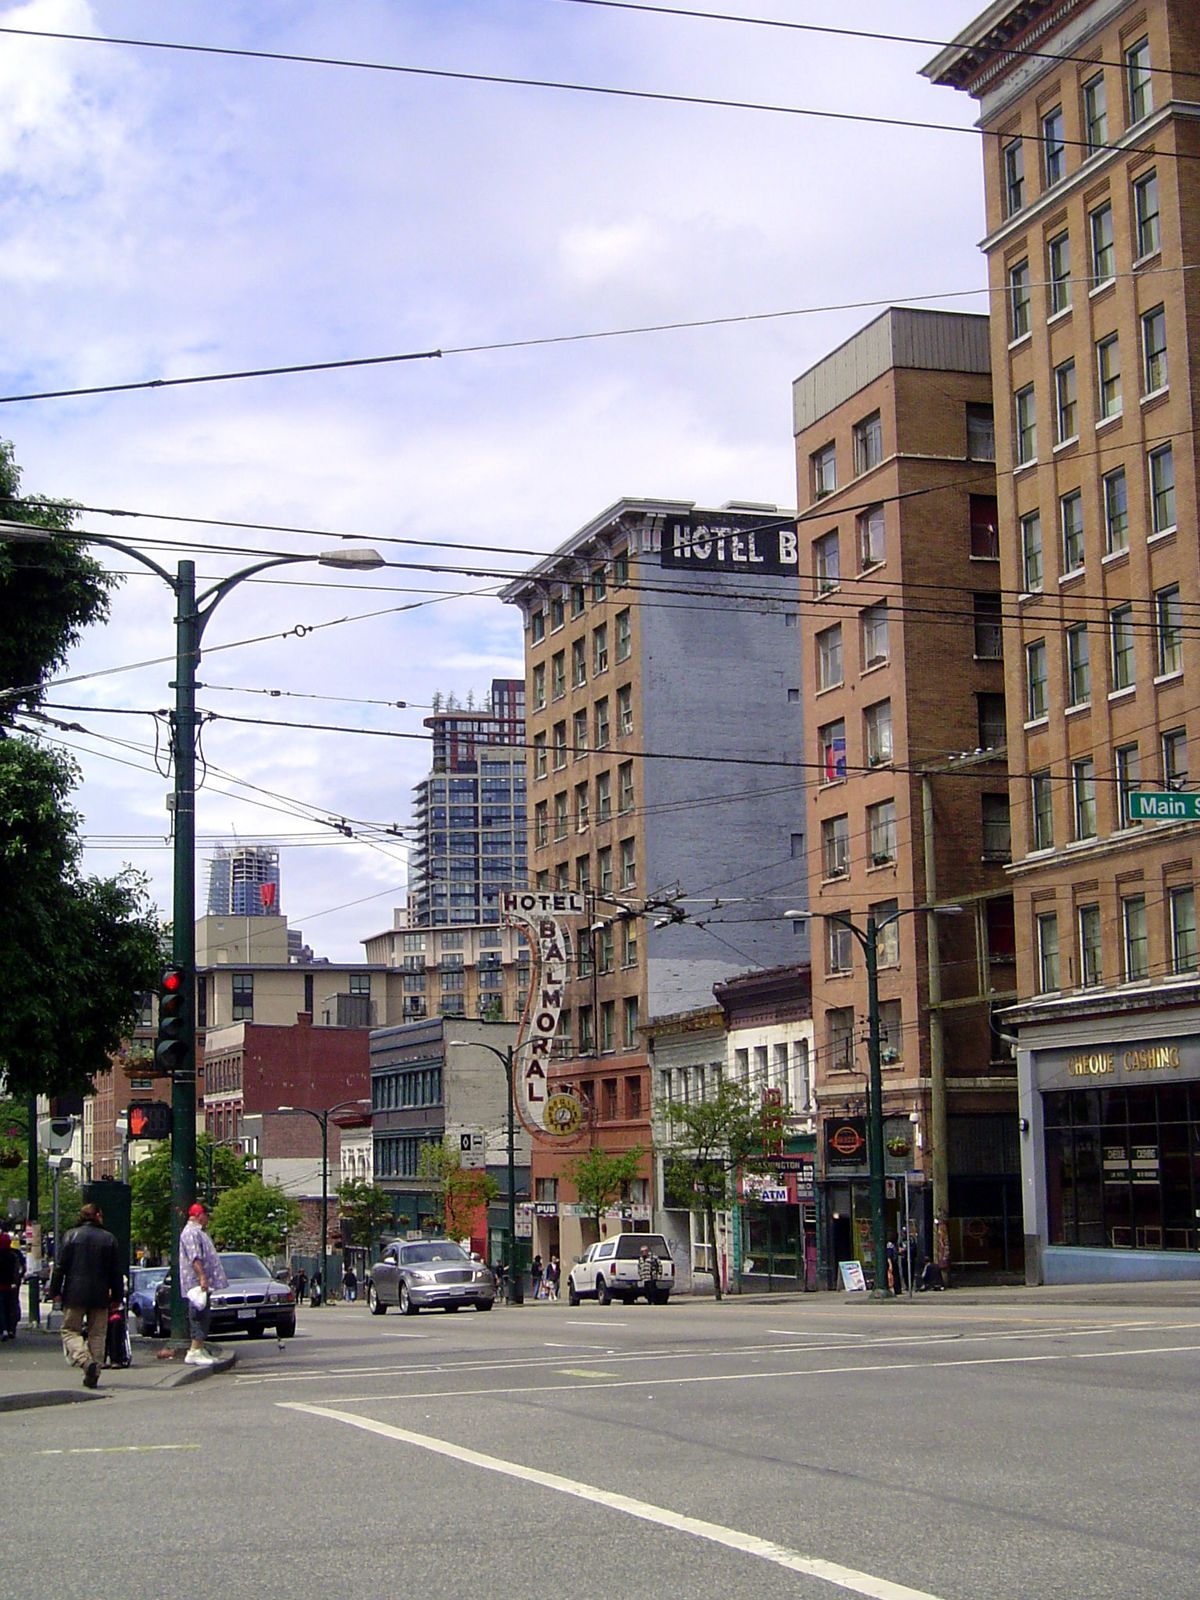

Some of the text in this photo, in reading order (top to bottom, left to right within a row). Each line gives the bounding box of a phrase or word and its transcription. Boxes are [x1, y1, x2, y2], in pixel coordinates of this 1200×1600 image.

[673, 524, 764, 563] HOTEL
[1140, 797, 1186, 815] Main
[504, 893, 582, 911] HOTEL
[526, 920, 564, 1102] BALMORAL
[1068, 1047, 1179, 1076] CHEQUE CASHING
[762, 1190, 786, 1200] ATM
[536, 1204, 556, 1214] PUB
